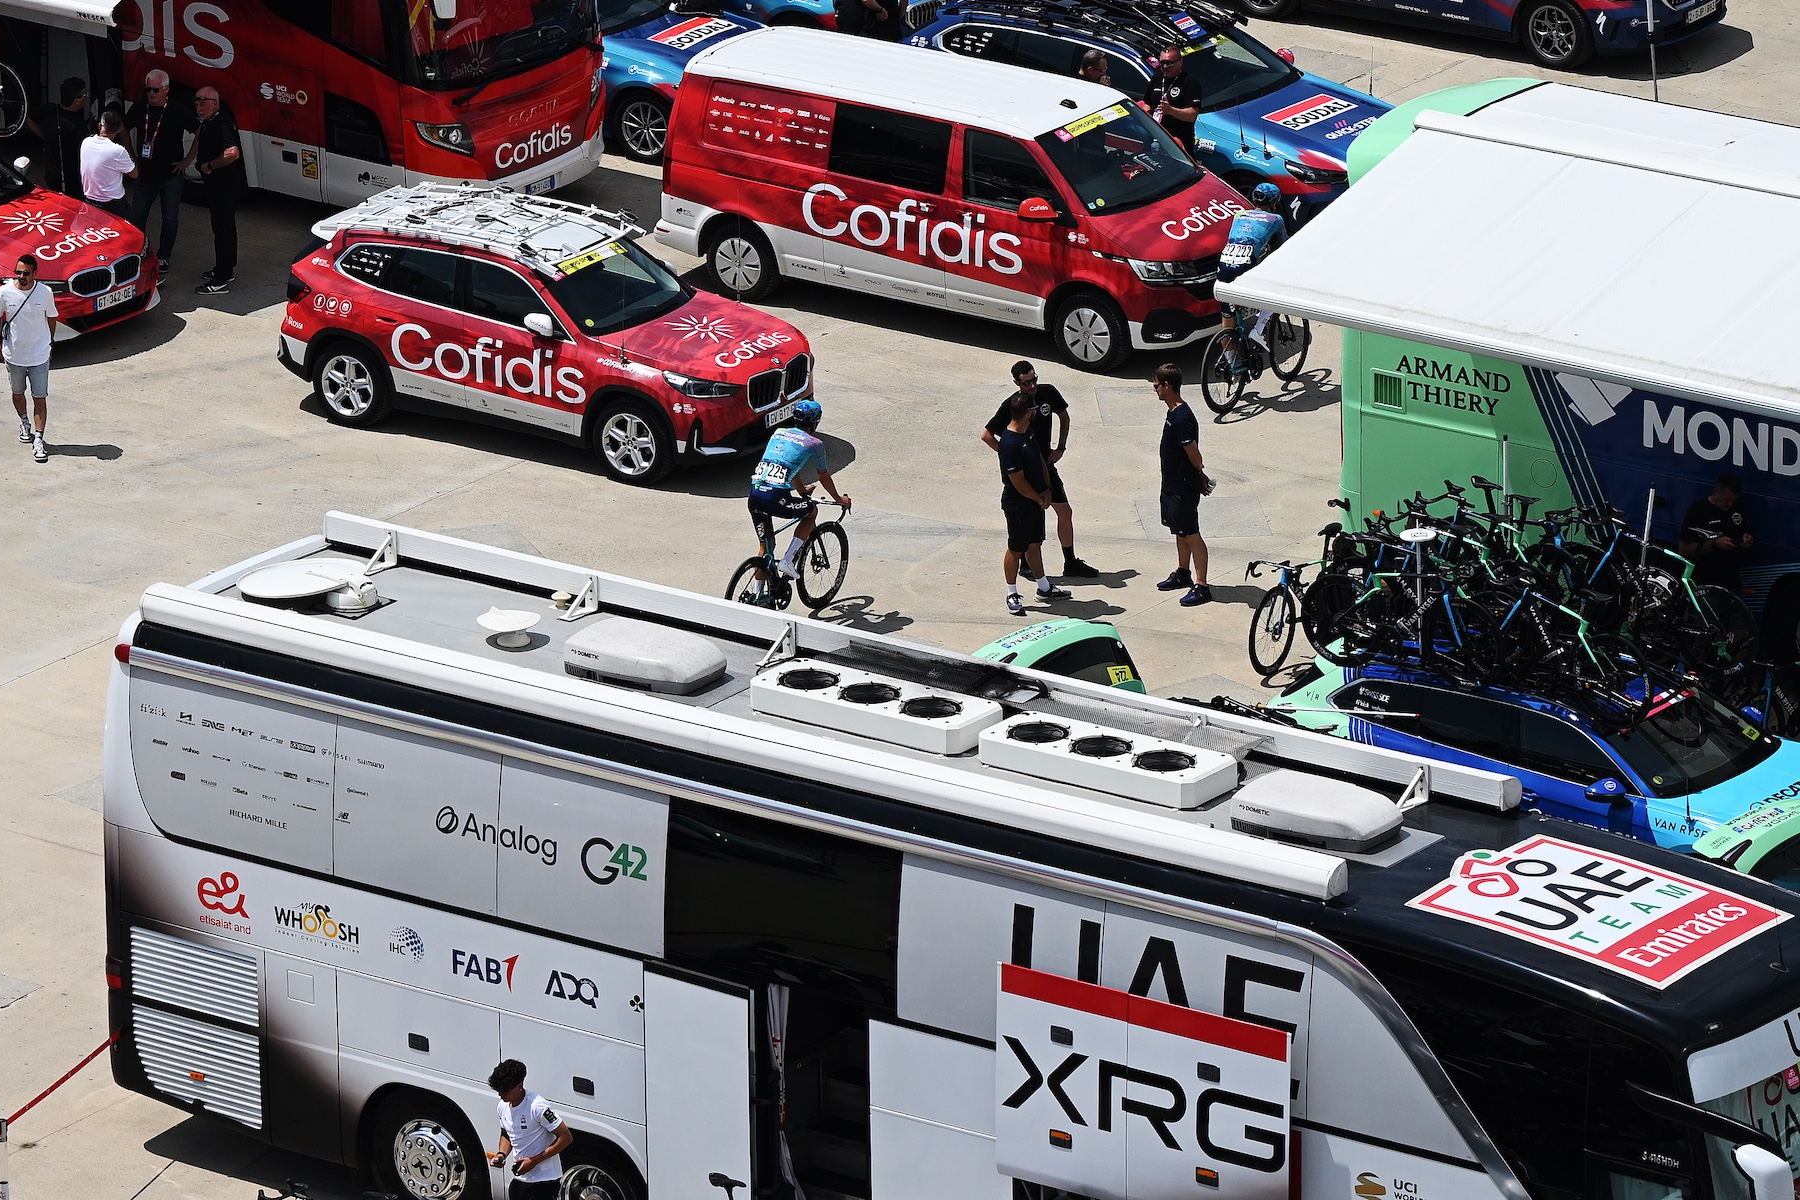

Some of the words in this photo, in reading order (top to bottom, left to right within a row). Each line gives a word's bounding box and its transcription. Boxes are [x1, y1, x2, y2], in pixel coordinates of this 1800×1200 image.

[666, 19, 734, 50] SOUDAL
[275, 84, 288, 93] UCI
[1282, 101, 1351, 130] SOUDAL
[495, 121, 573, 170] Cofidis
[801, 182, 1024, 275] Cofidis
[1161, 198, 1244, 241] Cofidis
[35, 224, 121, 261] Cofidis
[790, 262, 818, 272] LOOK
[925, 291, 946, 300] MOTUL
[390, 322, 587, 405] Cofidis
[714, 330, 793, 368] Cofidis
[1396, 353, 1512, 394] ARMAND
[1406, 380, 1500, 417] THIERY
[767, 463, 786, 480] 225
[181, 745, 201, 756] wahoo
[357, 757, 386, 771] SHIMANO
[229, 808, 264, 825] RICHARD
[264, 817, 288, 830] MILLE
[1653, 816, 1677, 834] VAN
[461, 811, 559, 866] Analog
[579, 836, 648, 886] G42
[1495, 860, 1655, 931] UAE
[199, 913, 232, 931] etisalat
[233, 920, 252, 936] and
[1568, 883, 1694, 946] TEAM
[274, 927, 298, 939] Indoor
[299, 933, 328, 947] Cycling
[329, 941, 361, 954] Solution
[388, 941, 407, 958] IHC
[1615, 899, 1749, 970] Emirates
[1001, 1033, 1287, 1172] XRG
[1392, 1178, 1419, 1195] UCI
